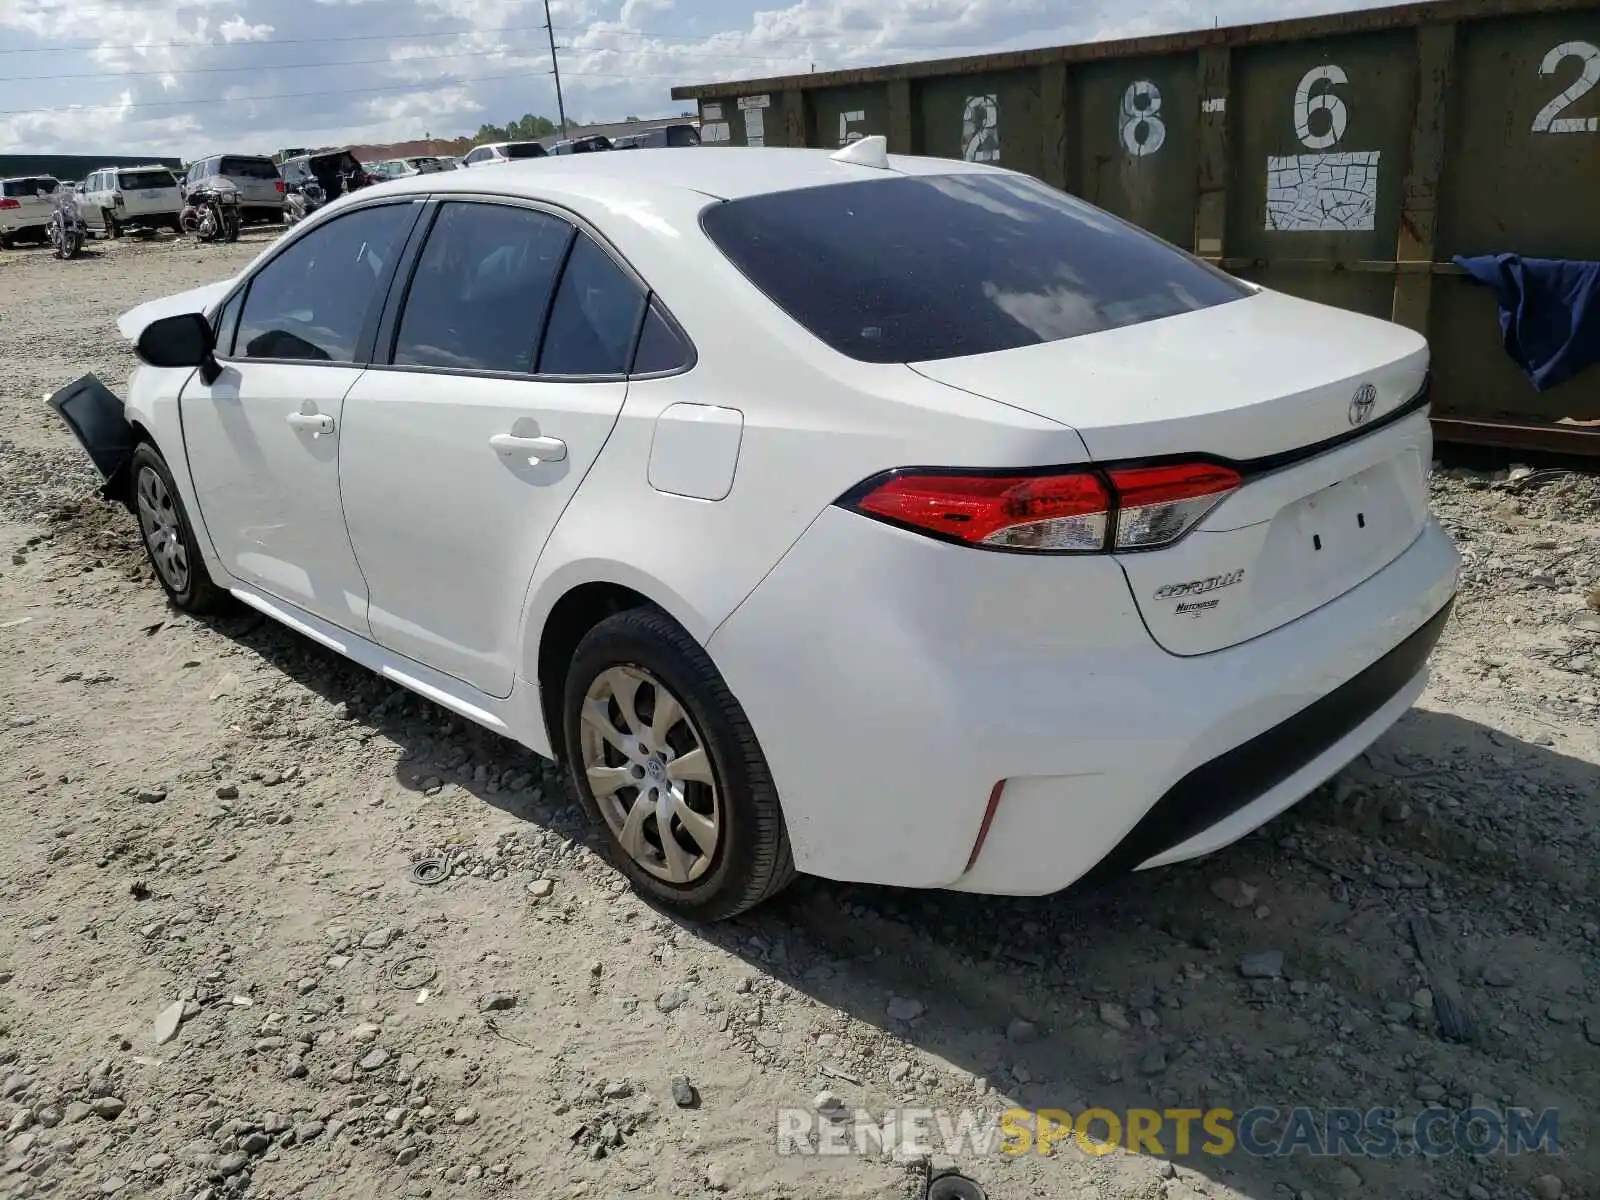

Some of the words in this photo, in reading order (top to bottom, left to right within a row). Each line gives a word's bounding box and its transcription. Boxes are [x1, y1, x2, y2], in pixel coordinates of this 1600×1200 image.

[962, 94, 1000, 161] 2
[1118, 80, 1166, 158] 8
[1294, 64, 1348, 149] 6
[1531, 41, 1600, 133] 2
